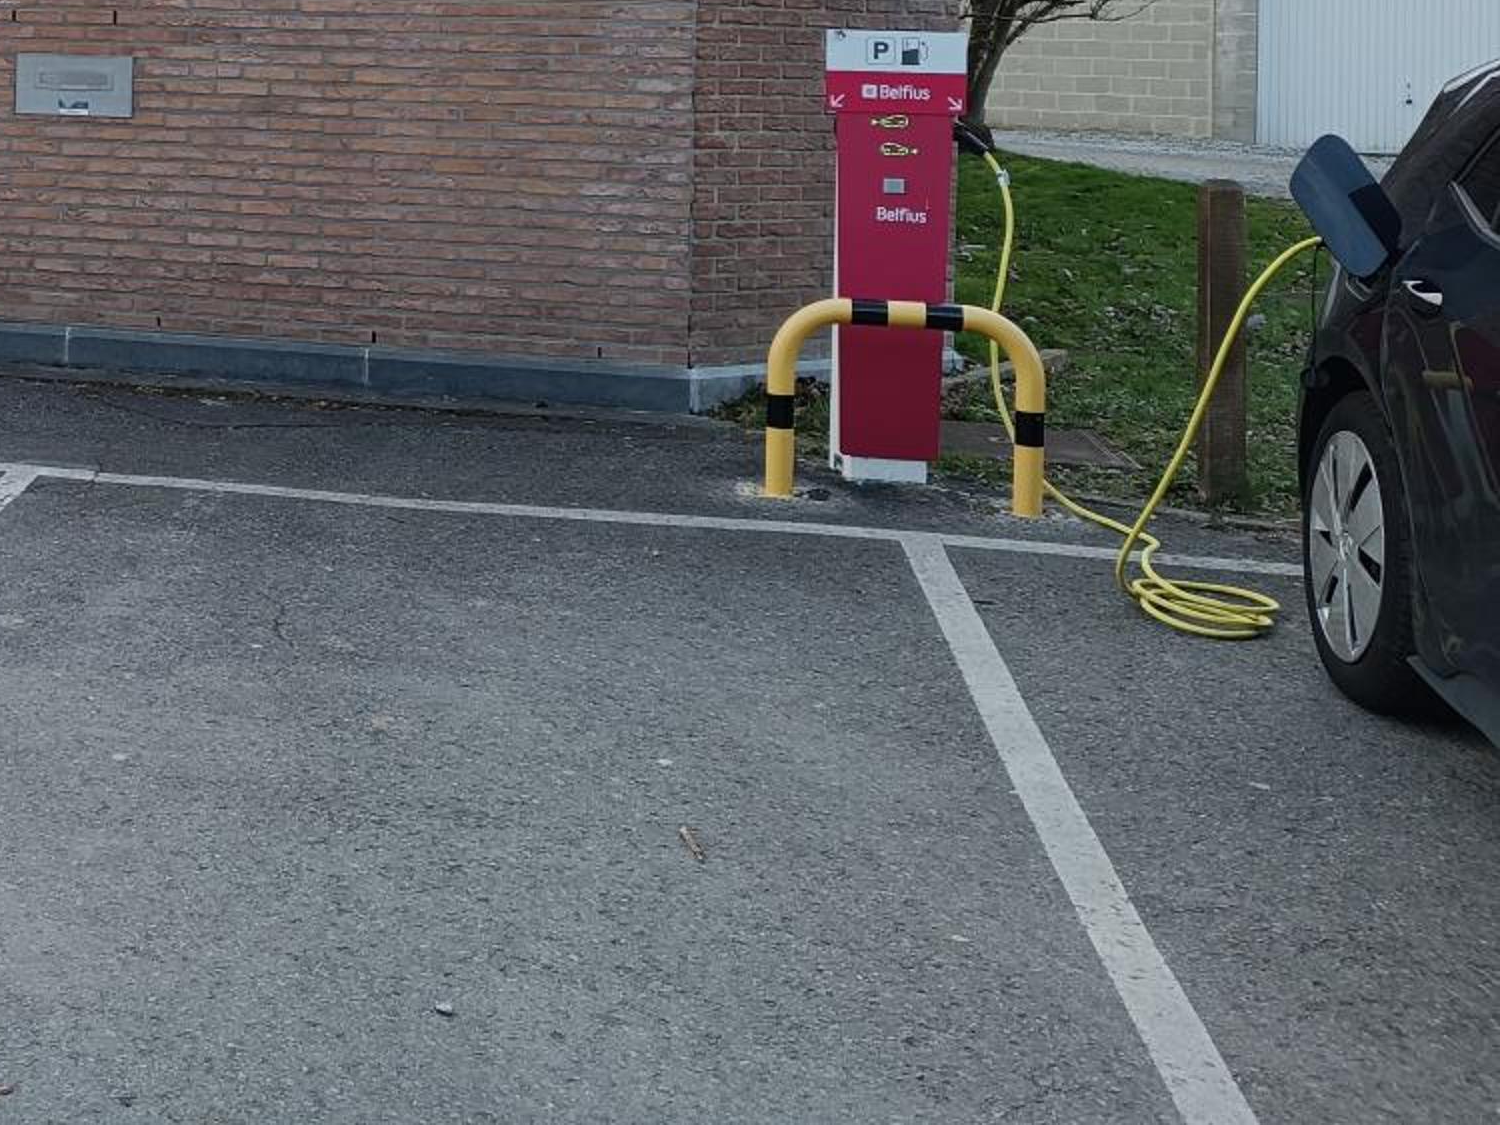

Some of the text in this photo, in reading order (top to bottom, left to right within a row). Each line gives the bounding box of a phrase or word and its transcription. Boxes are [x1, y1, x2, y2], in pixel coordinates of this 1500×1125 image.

[873, 41, 889, 60] P
[879, 84, 931, 100] Belfius
[876, 205, 927, 224] Belfius
